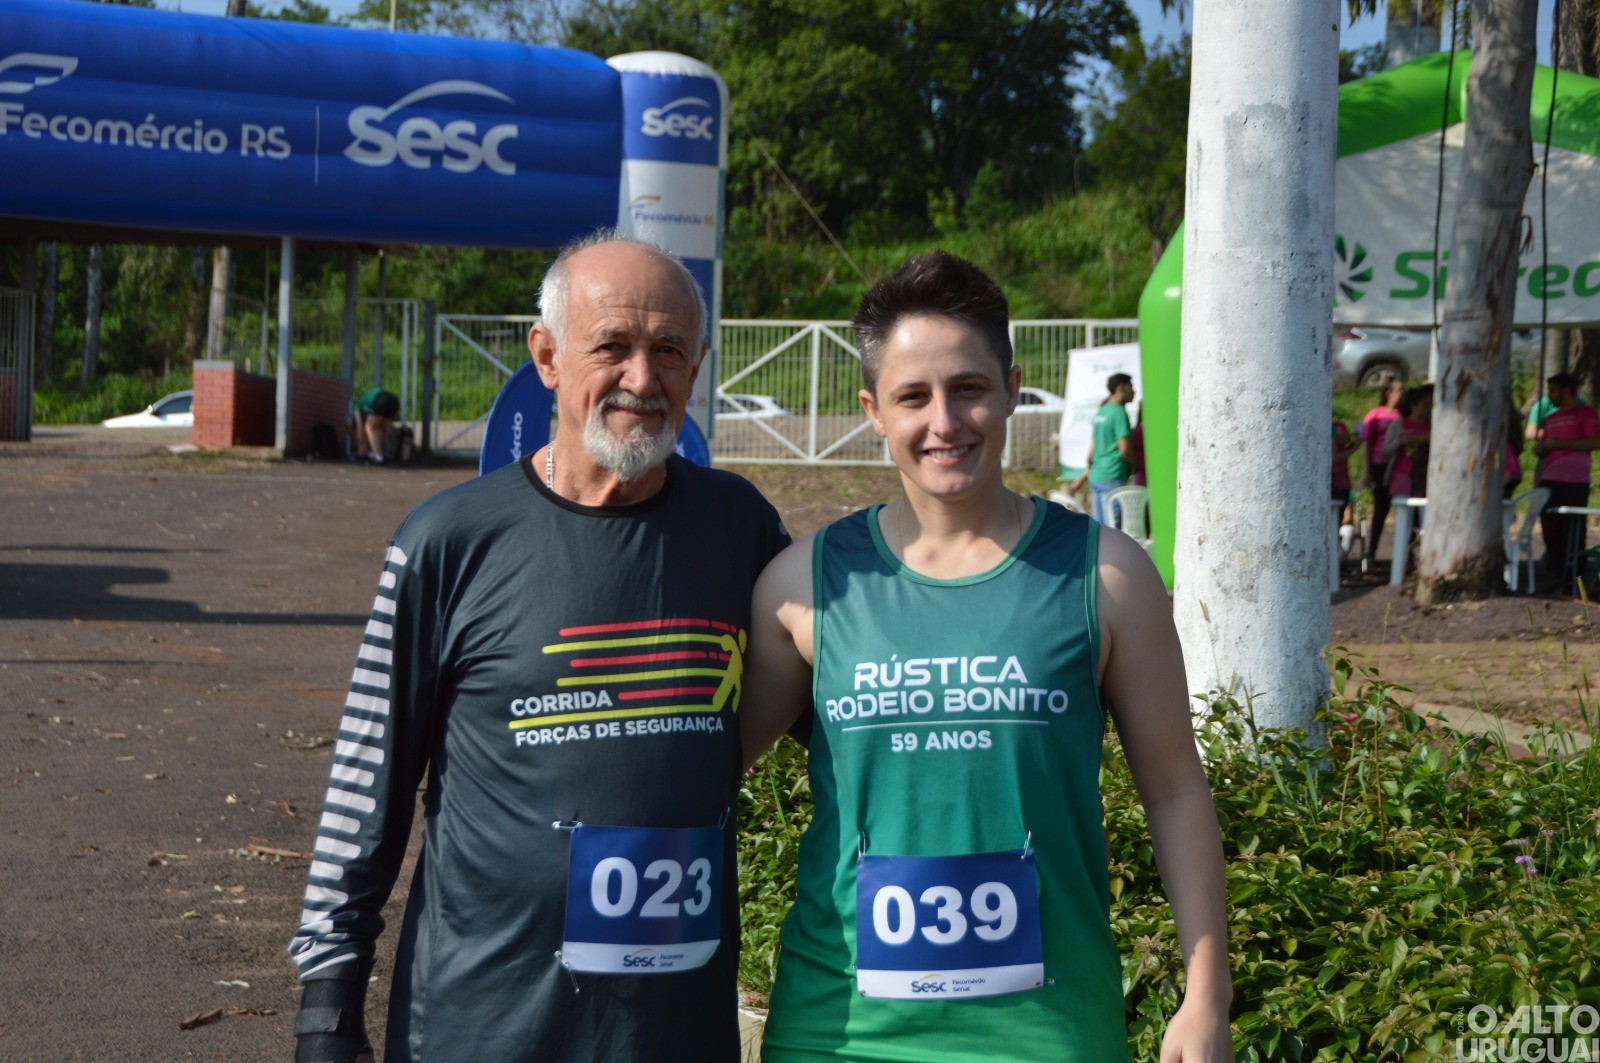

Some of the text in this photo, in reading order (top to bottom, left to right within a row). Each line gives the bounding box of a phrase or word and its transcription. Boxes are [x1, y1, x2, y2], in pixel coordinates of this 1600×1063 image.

[0, 102, 292, 160] Fecomércio RS
[641, 107, 713, 140] Sesc
[343, 106, 519, 176] Sesc
[854, 654, 1028, 690] RÚSTICA
[510, 689, 613, 716] CORRIDA
[826, 687, 1069, 723] RODEIO BONITO
[515, 716, 724, 746] FORÇAS DE SEGURANÇA
[891, 730, 992, 751] 59 ANOS
[591, 857, 712, 917] 023
[873, 881, 1018, 944] 039
[623, 954, 656, 967] Sesc
[911, 981, 947, 993] Sesc
